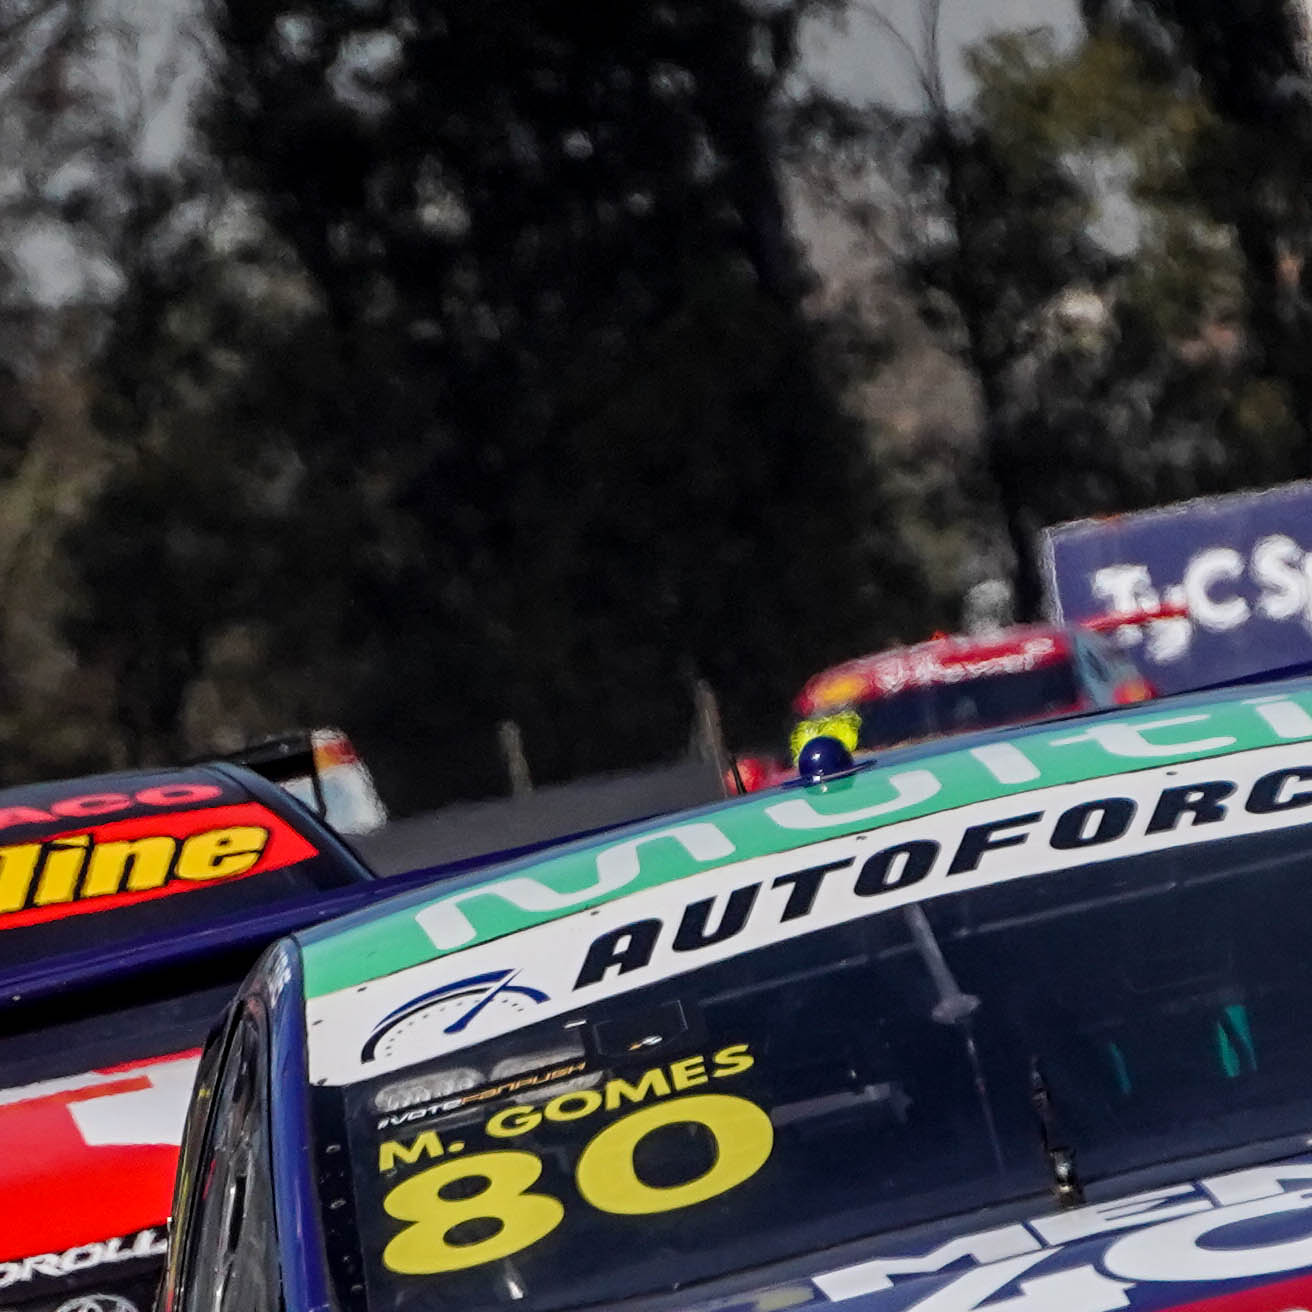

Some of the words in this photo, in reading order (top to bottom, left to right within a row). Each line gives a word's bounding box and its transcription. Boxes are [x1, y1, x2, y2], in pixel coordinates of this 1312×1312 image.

[1092, 547, 1251, 663] TyC
[378, 1130, 465, 1173] M.
[486, 1043, 755, 1139] GOMES
[382, 1093, 775, 1276] 80
